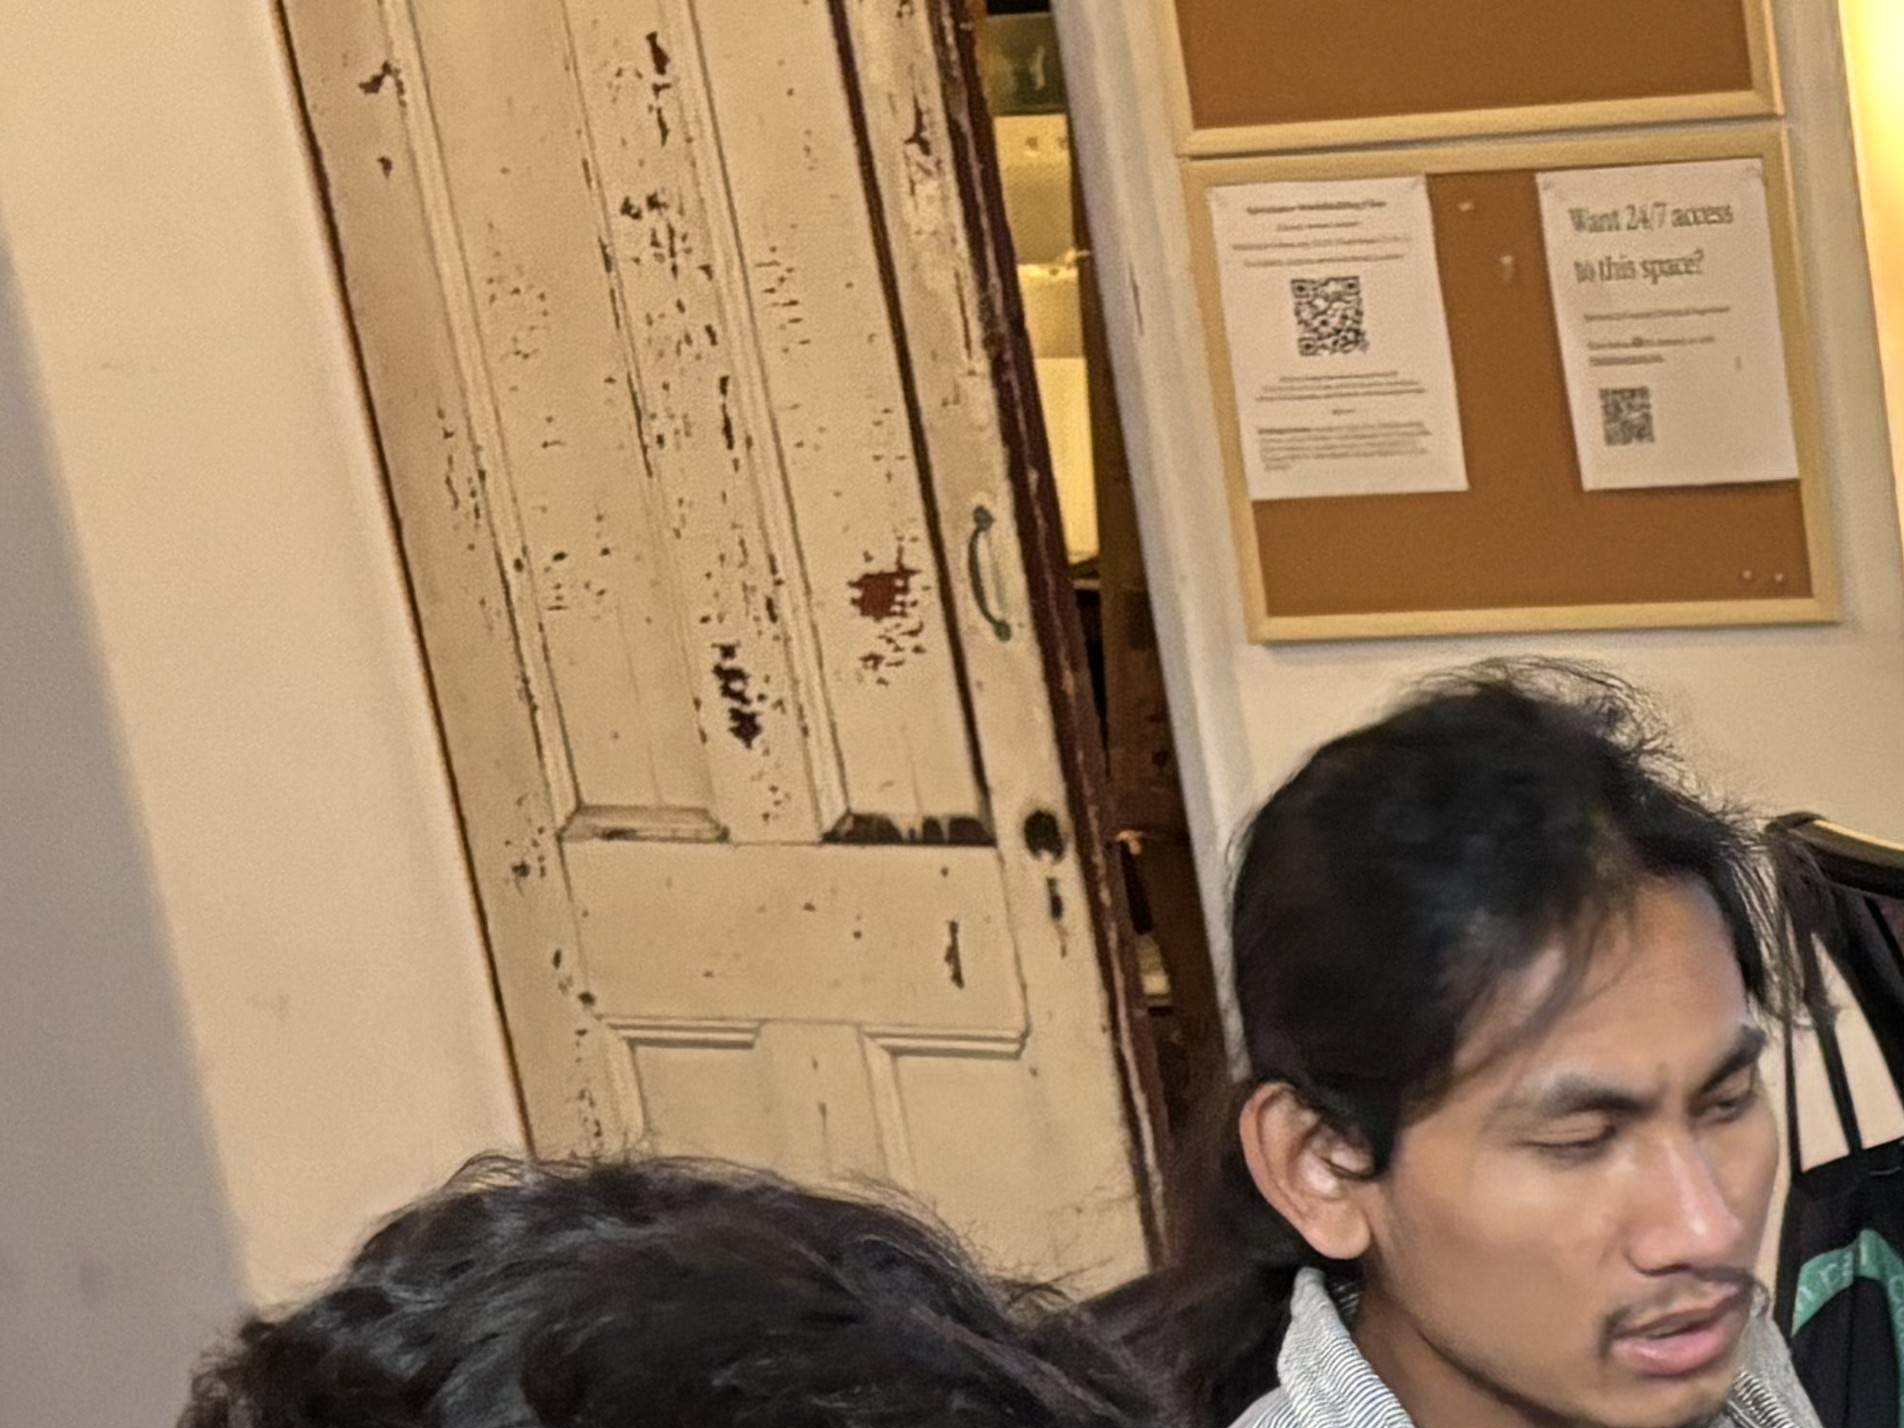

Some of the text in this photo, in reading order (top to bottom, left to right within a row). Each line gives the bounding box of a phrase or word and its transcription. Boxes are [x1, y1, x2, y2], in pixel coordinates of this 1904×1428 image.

[1568, 201, 1734, 233] Want 24/7 access
[1573, 261, 1596, 284] to
[1598, 255, 1636, 282] this
